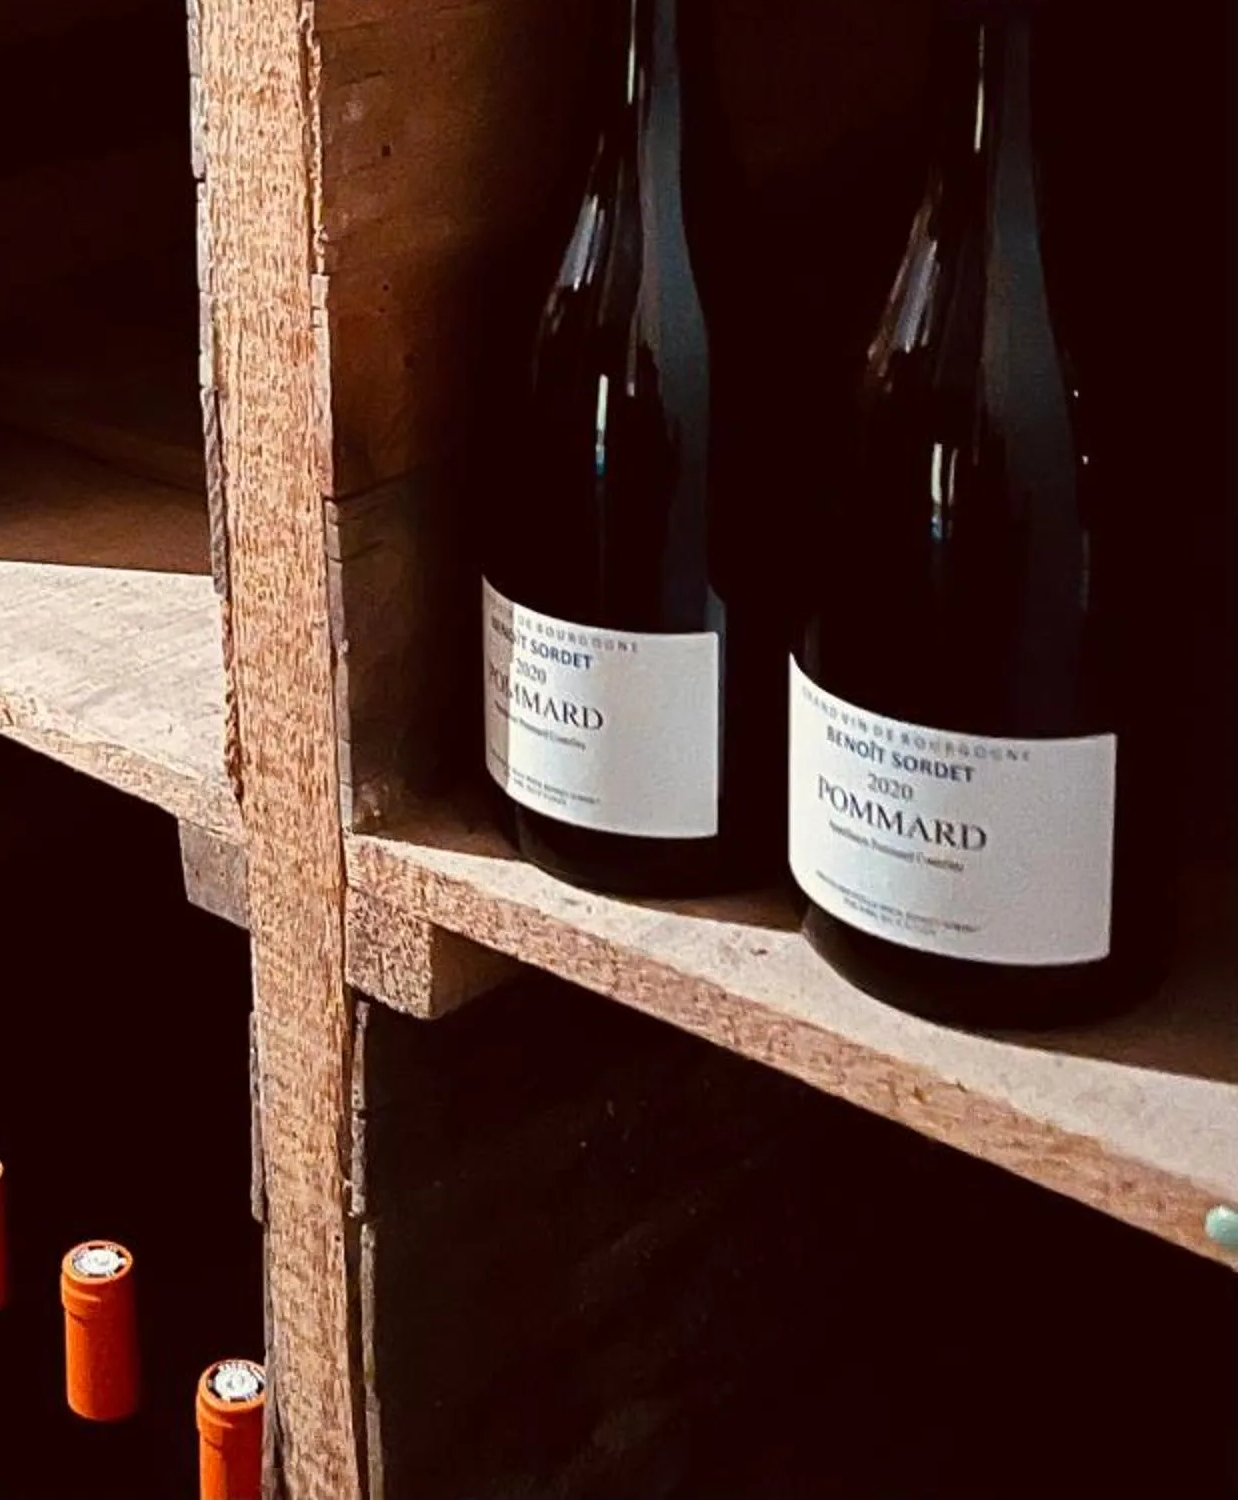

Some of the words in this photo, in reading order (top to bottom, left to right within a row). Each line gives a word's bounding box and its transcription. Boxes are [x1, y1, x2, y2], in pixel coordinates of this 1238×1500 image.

[529, 637, 595, 671] SORDET
[891, 751, 976, 784] SORDET
[867, 771, 914, 801] 2020
[817, 774, 988, 852] POMMARD
